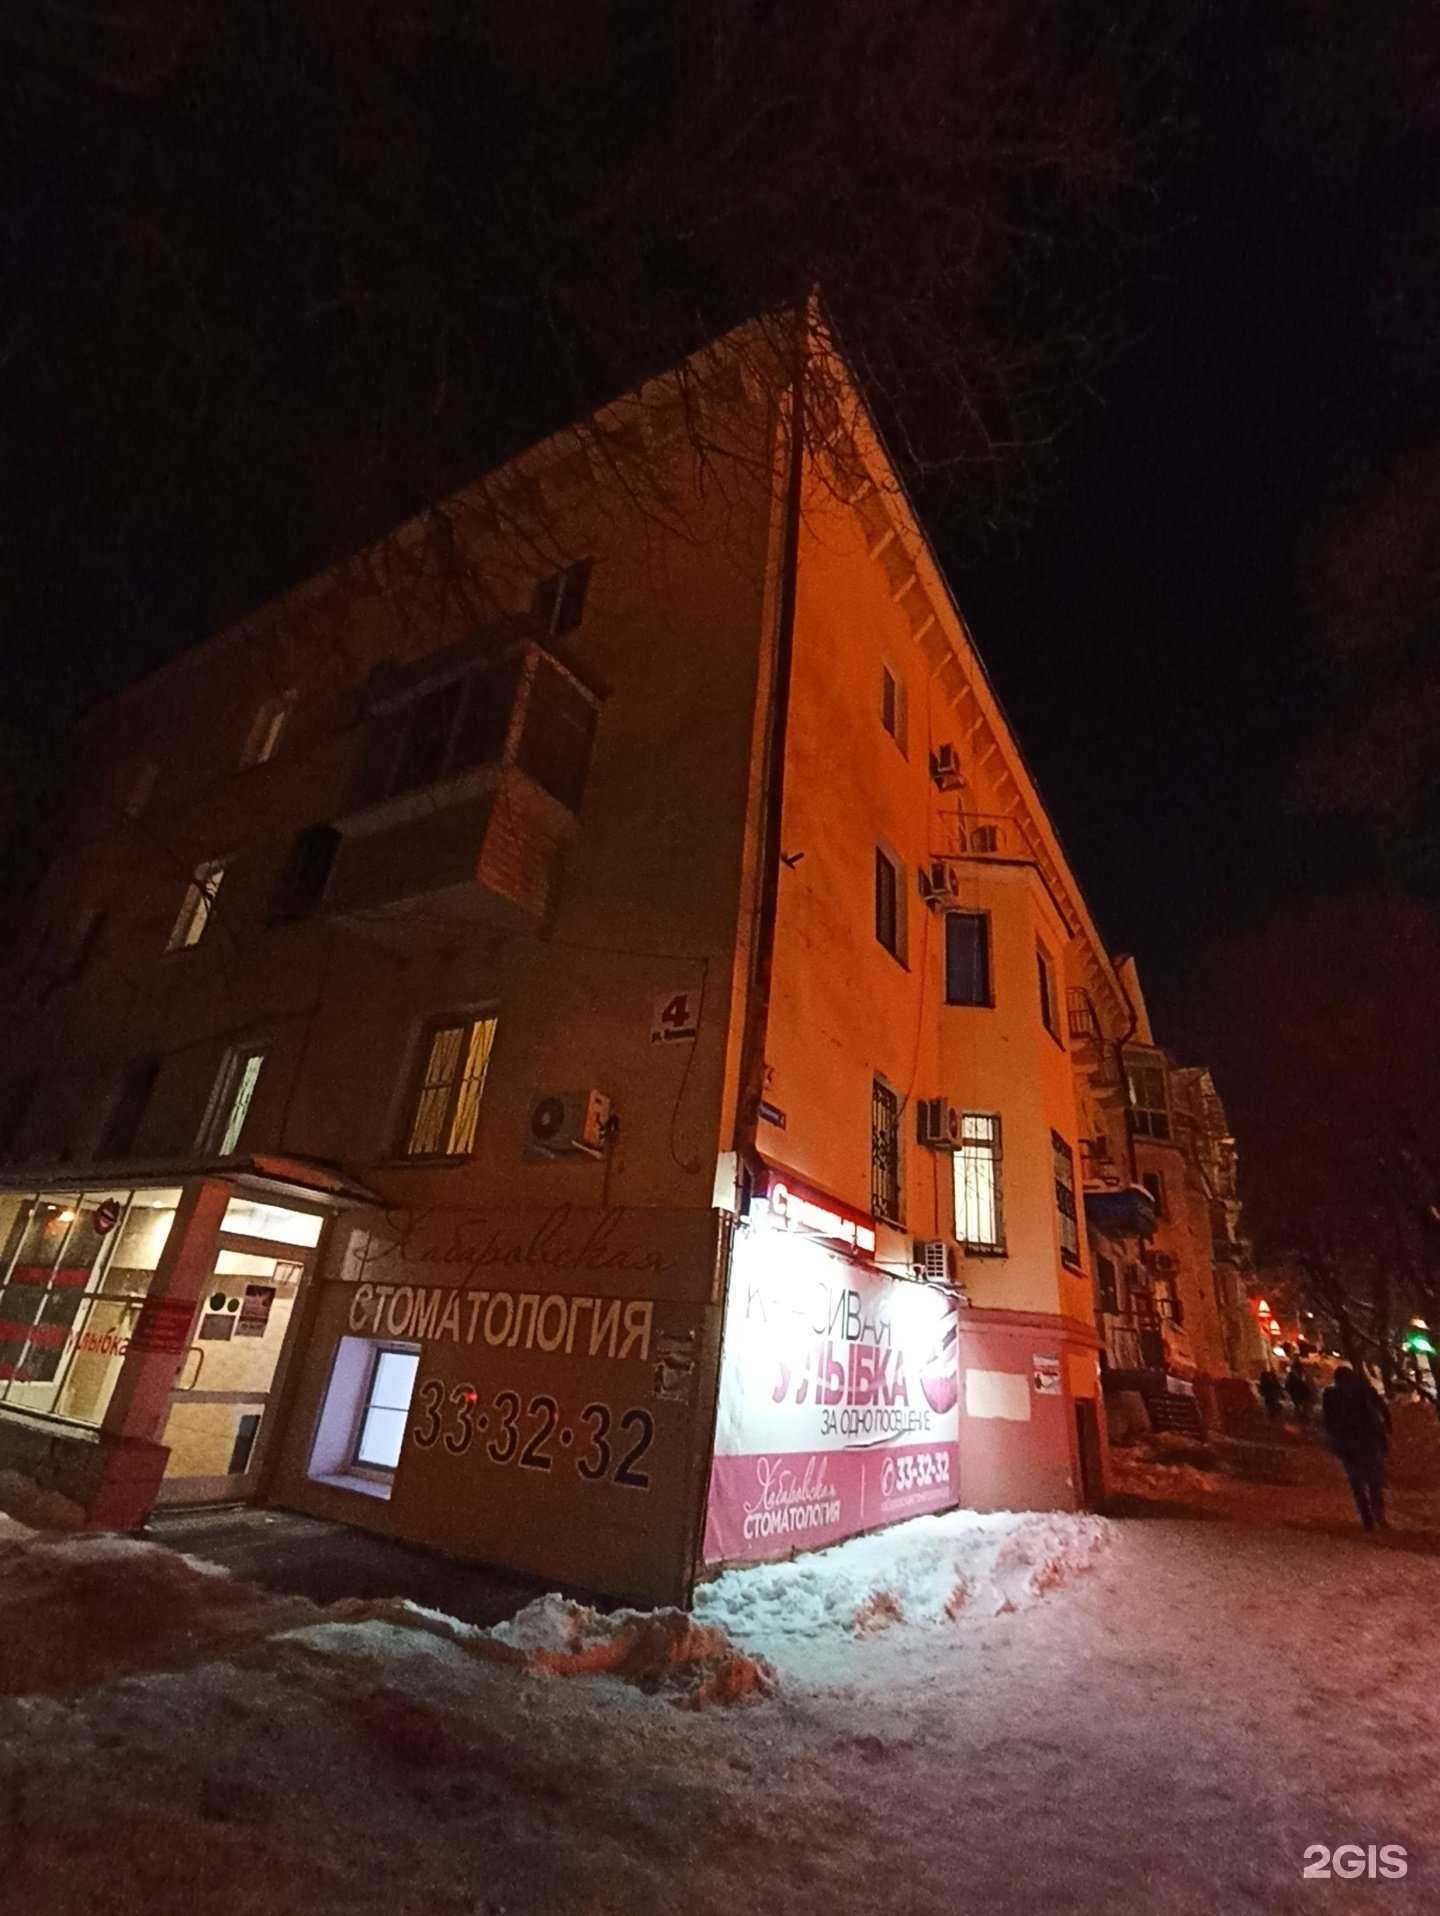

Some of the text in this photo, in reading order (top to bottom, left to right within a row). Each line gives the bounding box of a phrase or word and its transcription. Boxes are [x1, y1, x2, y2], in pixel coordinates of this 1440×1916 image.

[662, 995, 690, 1027] 4
[350, 1283, 654, 1361] СТОМАТОЛОГИЯ
[744, 1283, 893, 1348] КСИВАЯ
[820, 1408, 839, 1437] ЗА
[839, 1408, 874, 1440] ОДНО
[743, 1500, 842, 1540] СТОМАТОЛОГИЯ
